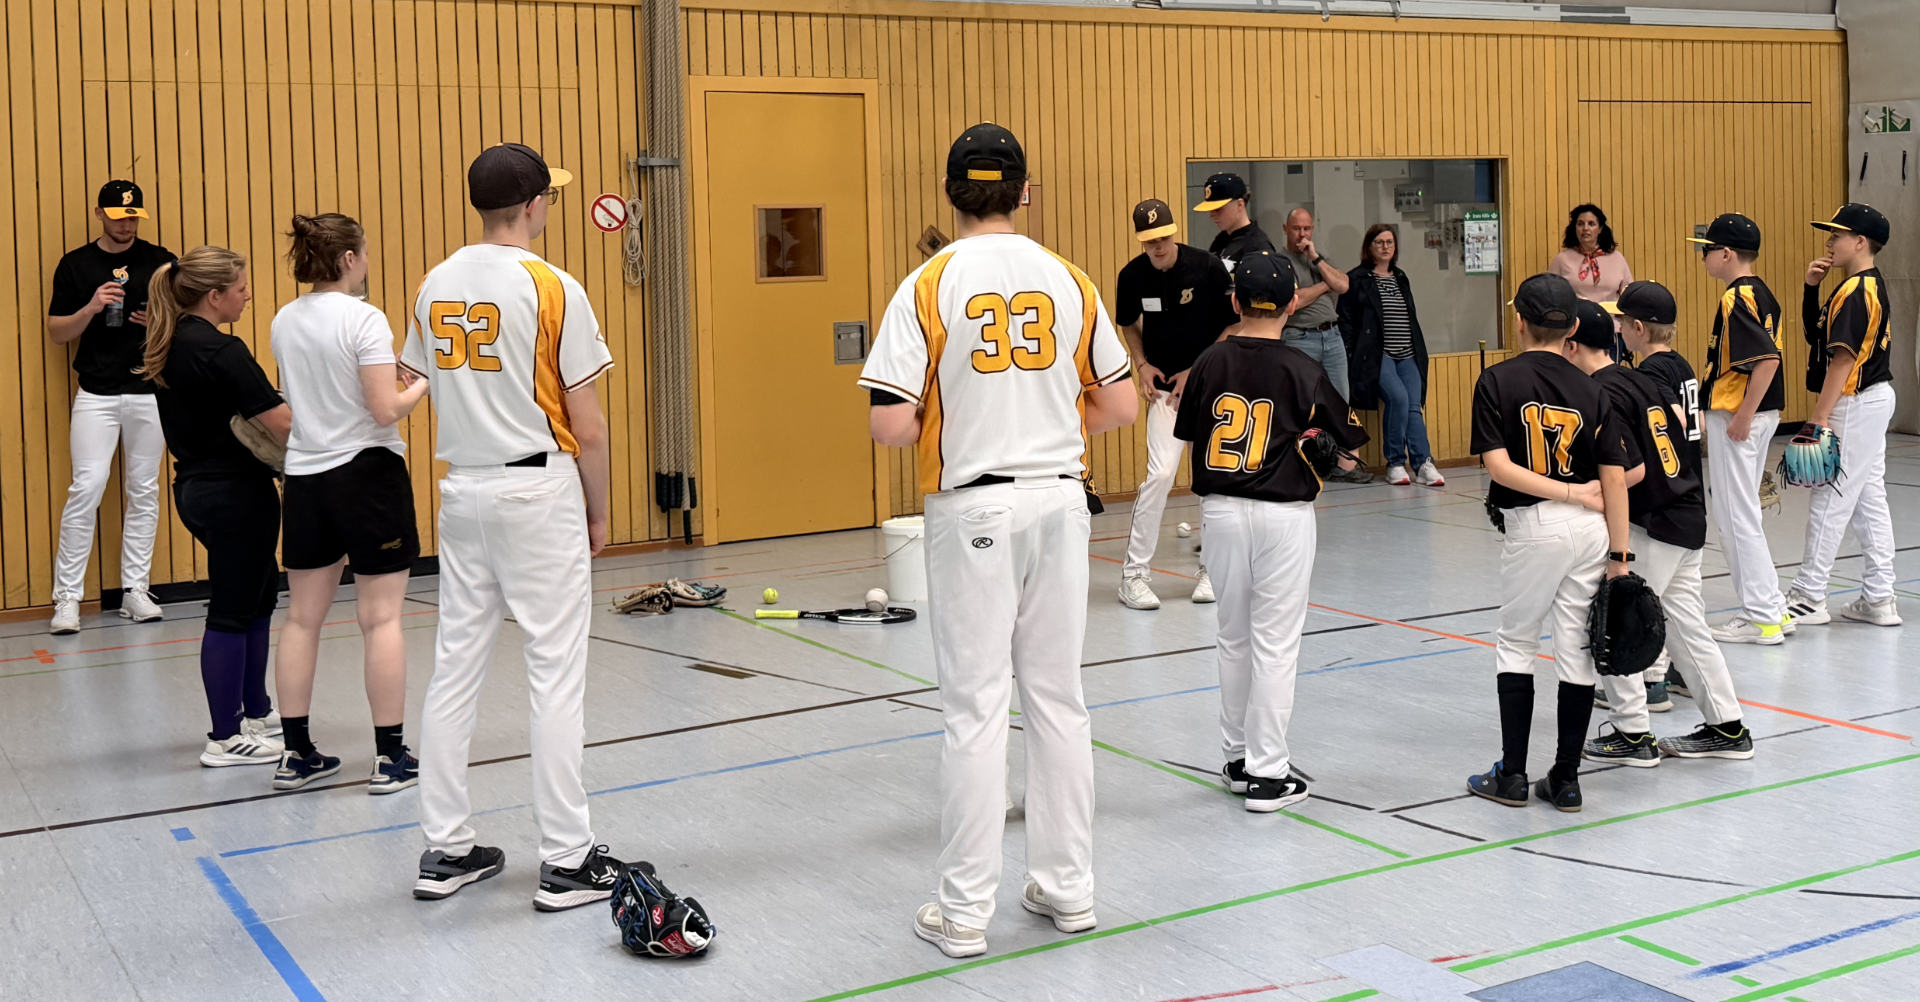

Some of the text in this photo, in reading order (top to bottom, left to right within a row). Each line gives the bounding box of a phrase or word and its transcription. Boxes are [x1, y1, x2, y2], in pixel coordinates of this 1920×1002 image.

[429, 301, 502, 372] 52
[965, 291, 1057, 374] 33
[1205, 392, 1274, 473] 21
[1520, 401, 1584, 477] 17
[1647, 405, 1681, 478] 6
